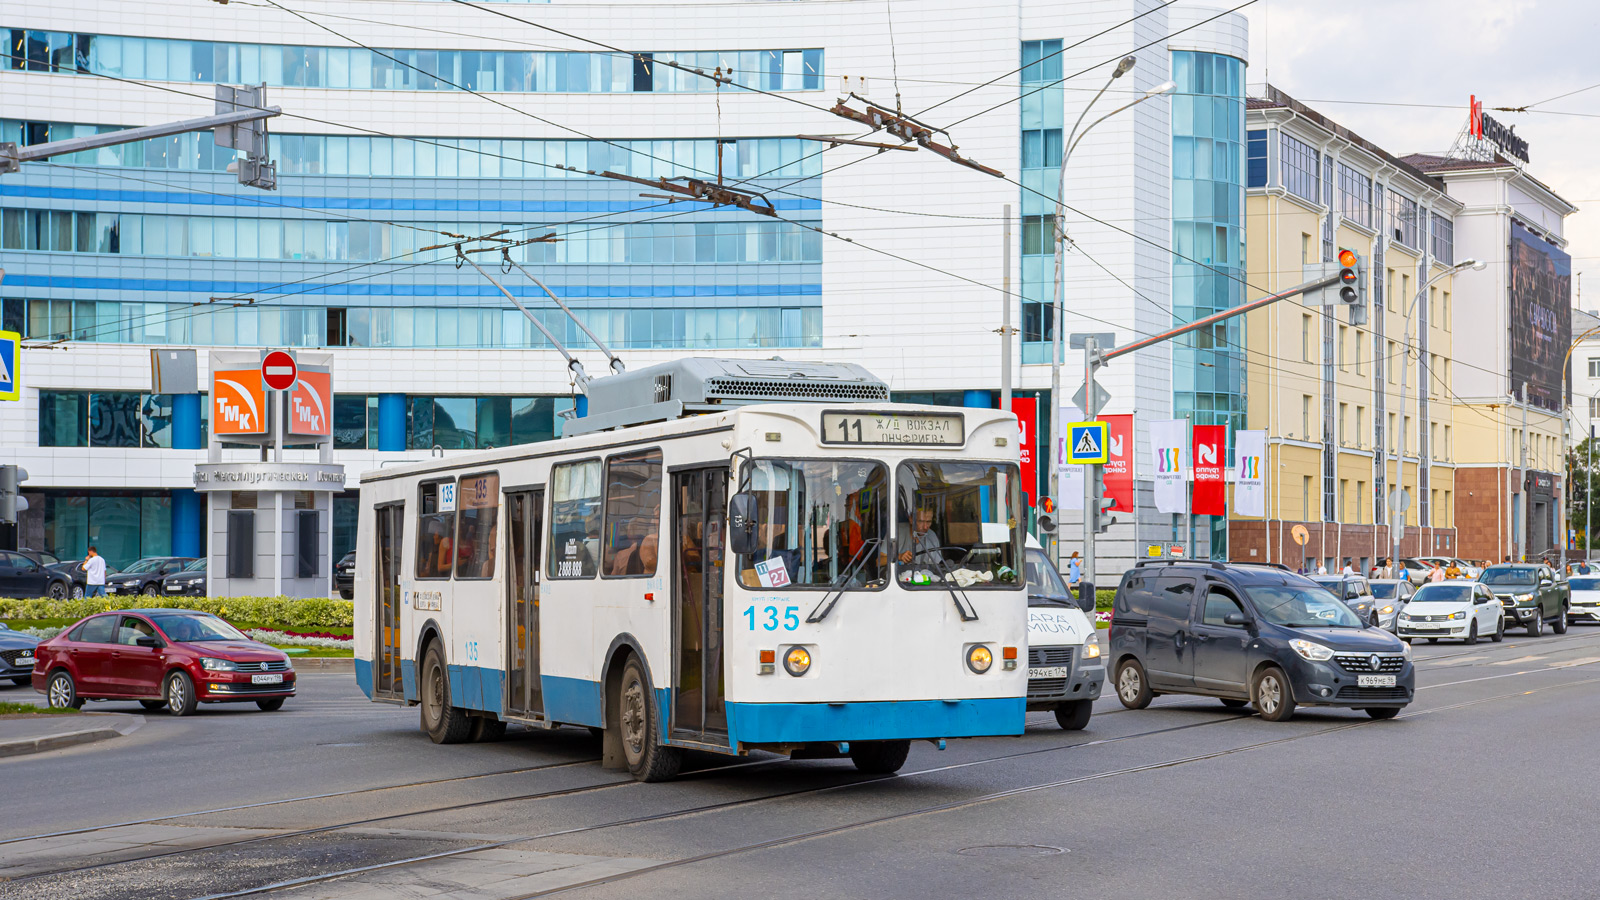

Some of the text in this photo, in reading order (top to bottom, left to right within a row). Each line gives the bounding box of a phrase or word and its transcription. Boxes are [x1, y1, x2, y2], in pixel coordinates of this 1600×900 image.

[216, 397, 250, 430] ТМК
[293, 397, 320, 431] ТМК
[838, 418, 862, 441] 11
[906, 420, 950, 431] ВОКЗАЛ
[442, 485, 454, 503] 135
[475, 479, 488, 500] 135
[770, 569, 786, 585] 27
[743, 605, 800, 631] 135
[465, 641, 479, 661] 135
